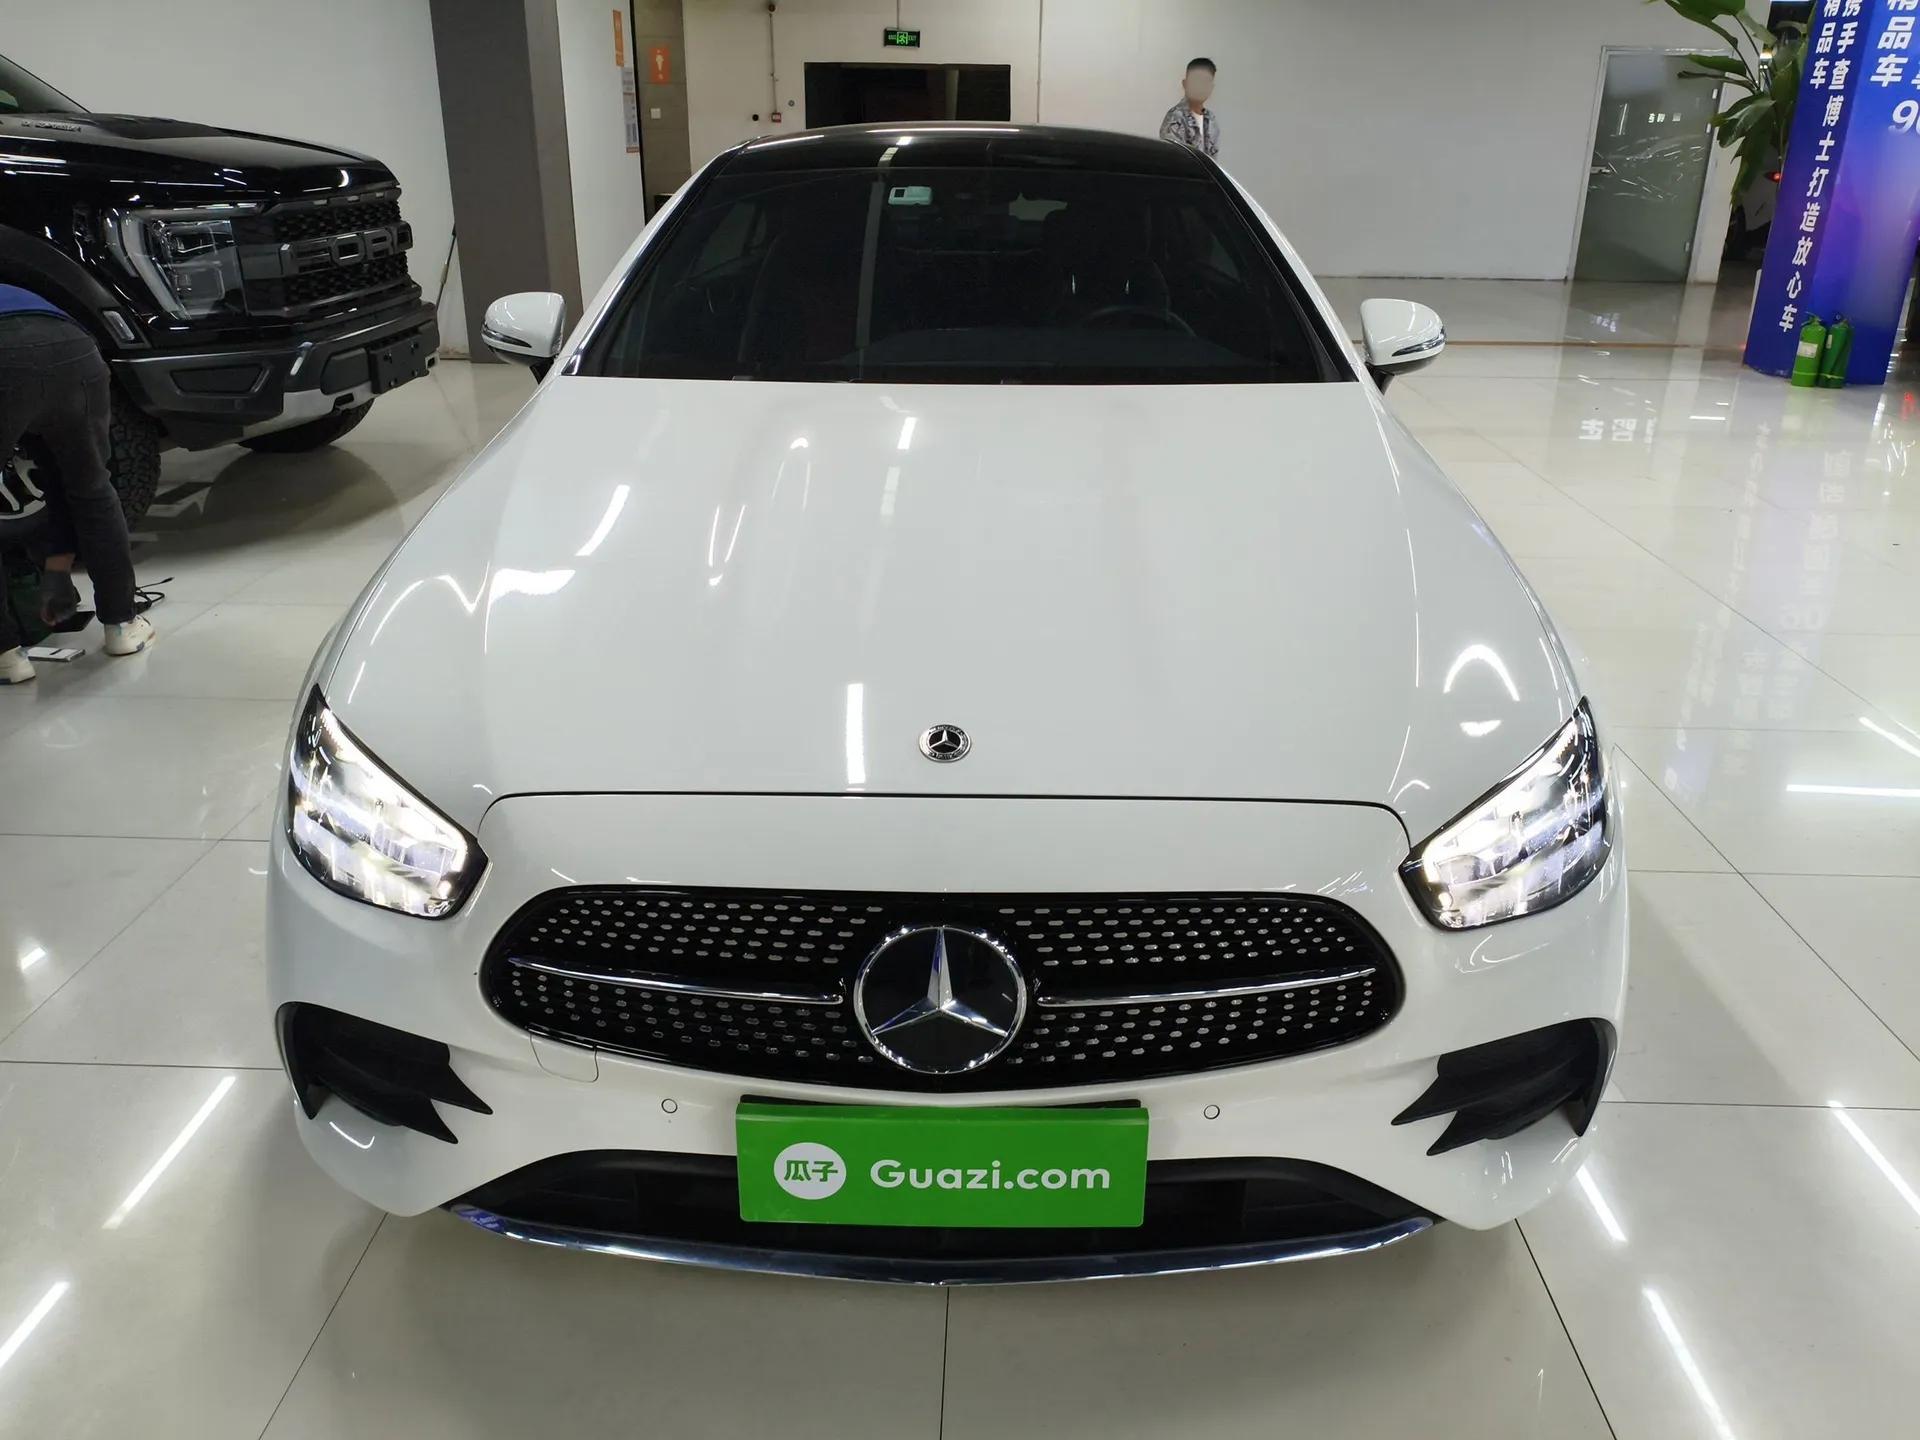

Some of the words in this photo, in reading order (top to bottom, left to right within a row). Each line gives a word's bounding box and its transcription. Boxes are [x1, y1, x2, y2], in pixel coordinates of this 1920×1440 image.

[280, 220, 413, 276] FORD
[783, 1159, 839, 1183] 瓜子
[870, 1160, 1111, 1190] Guazi.com
